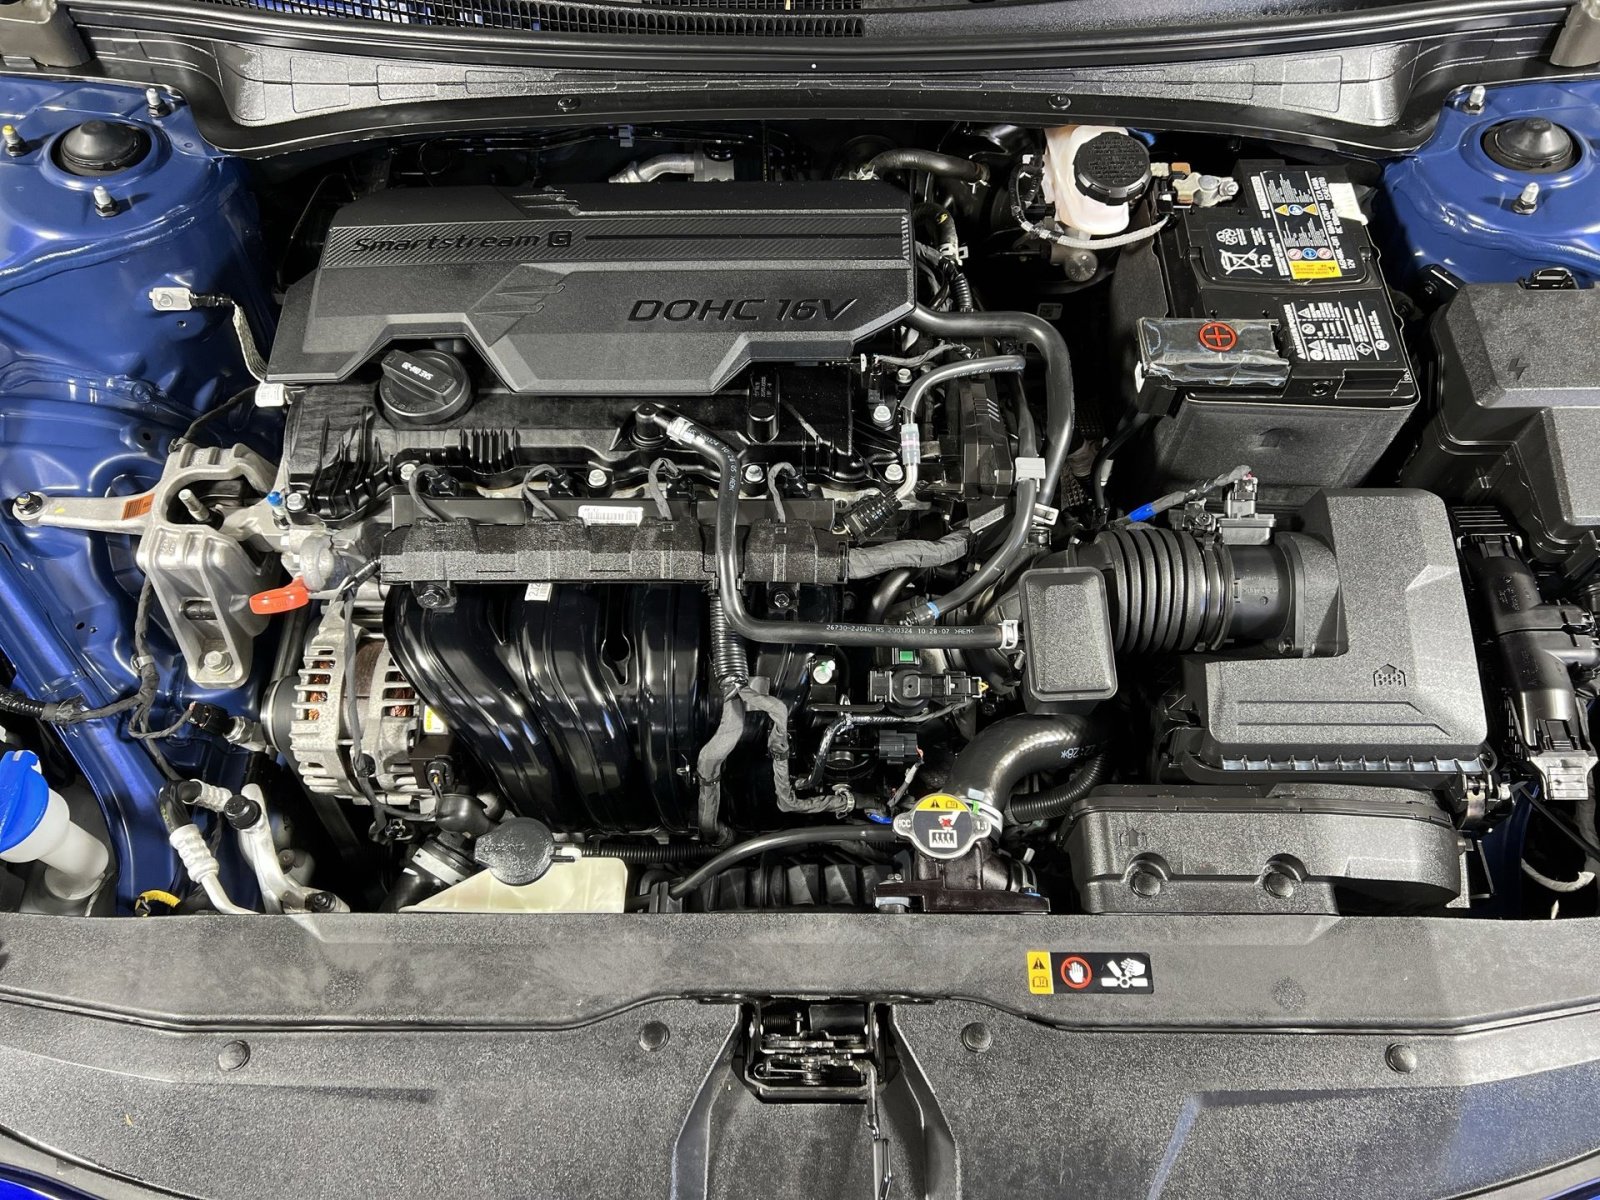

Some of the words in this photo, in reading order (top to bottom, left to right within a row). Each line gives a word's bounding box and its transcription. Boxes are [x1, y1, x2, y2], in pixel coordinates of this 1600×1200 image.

[351, 235, 541, 251] Smartstream
[551, 230, 572, 247] G
[1259, 254, 1274, 268] Pb
[628, 299, 767, 322] DOHC
[776, 298, 858, 321] 16V
